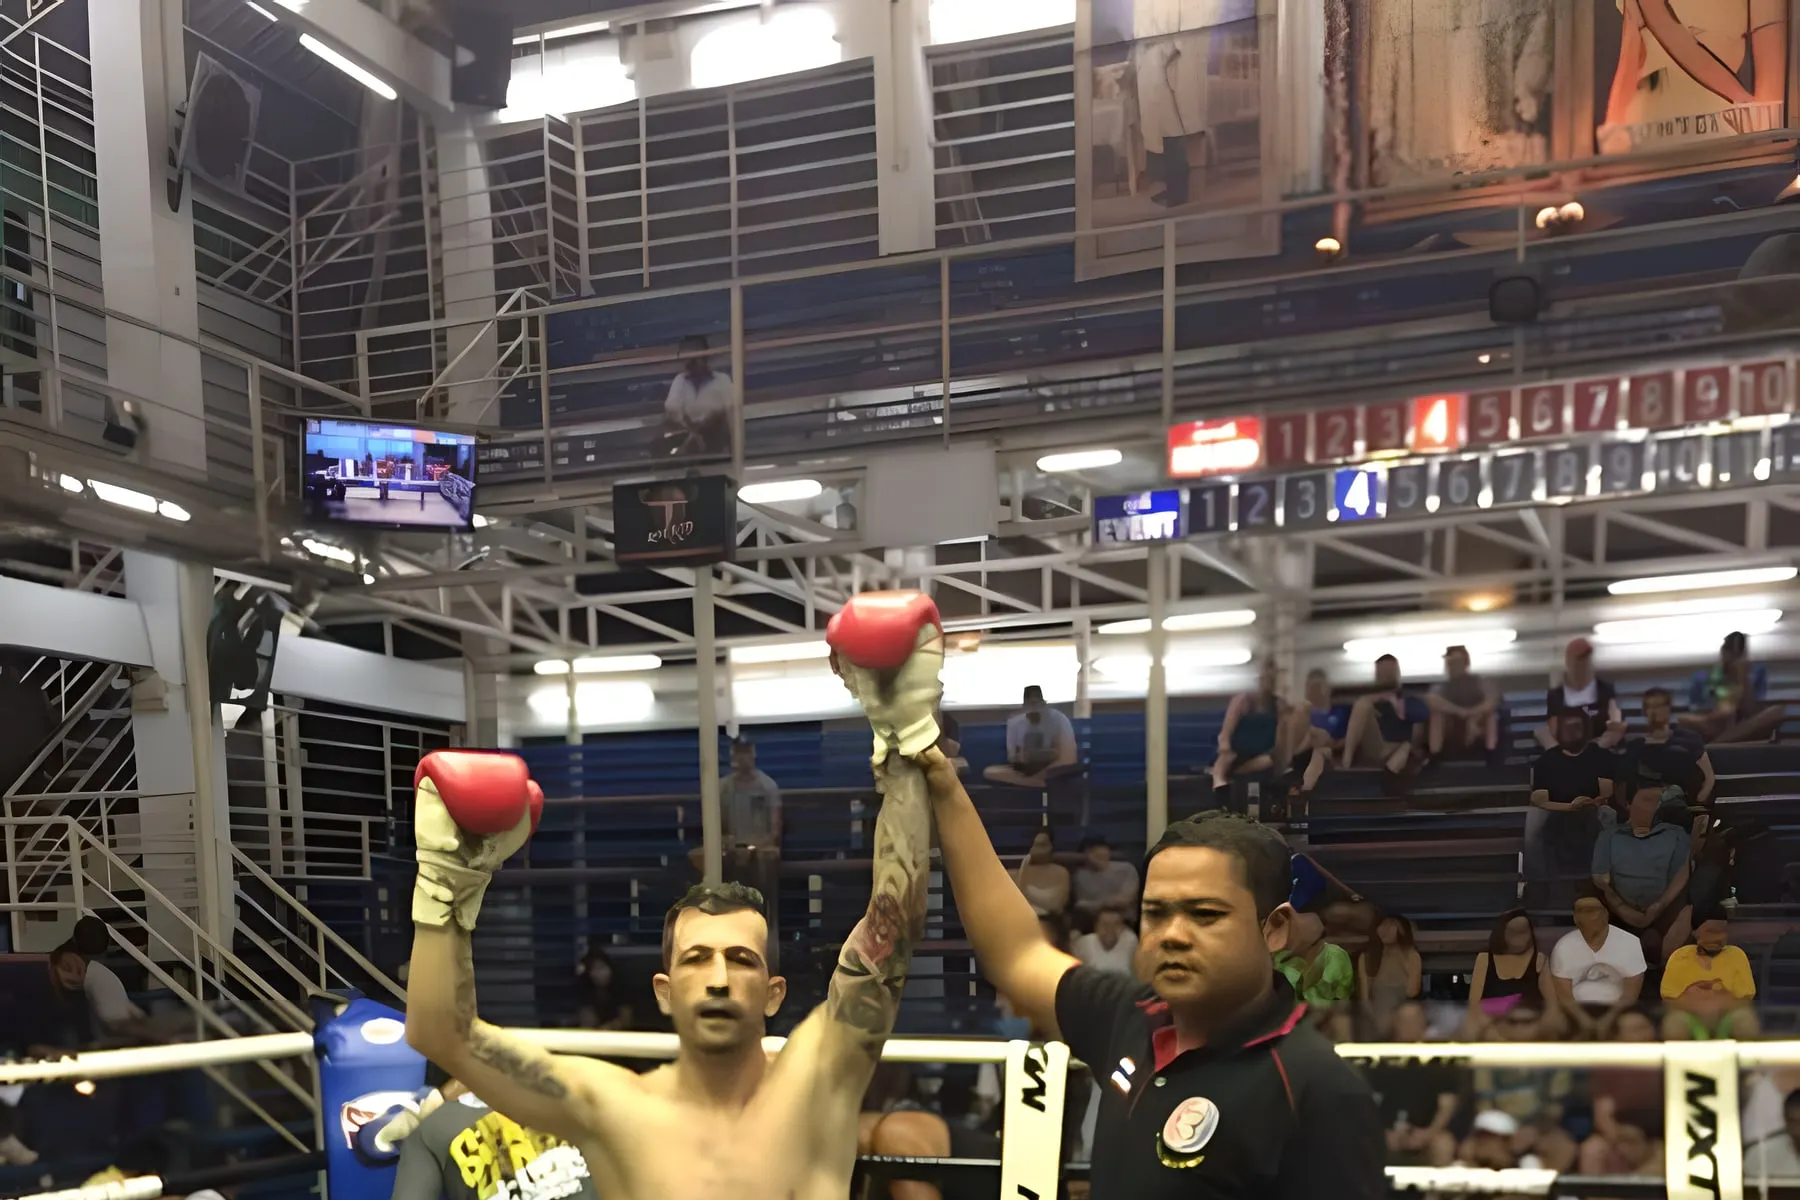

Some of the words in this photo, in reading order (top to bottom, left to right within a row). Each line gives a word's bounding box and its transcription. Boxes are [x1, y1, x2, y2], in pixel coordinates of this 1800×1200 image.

[1423, 399, 1448, 443] 4
[1478, 396, 1501, 438] 5
[1532, 389, 1554, 432] 6
[1588, 384, 1610, 428] 7
[1696, 373, 1719, 415] 9
[1344, 470, 1371, 516] 4
[1448, 460, 1470, 504] 6
